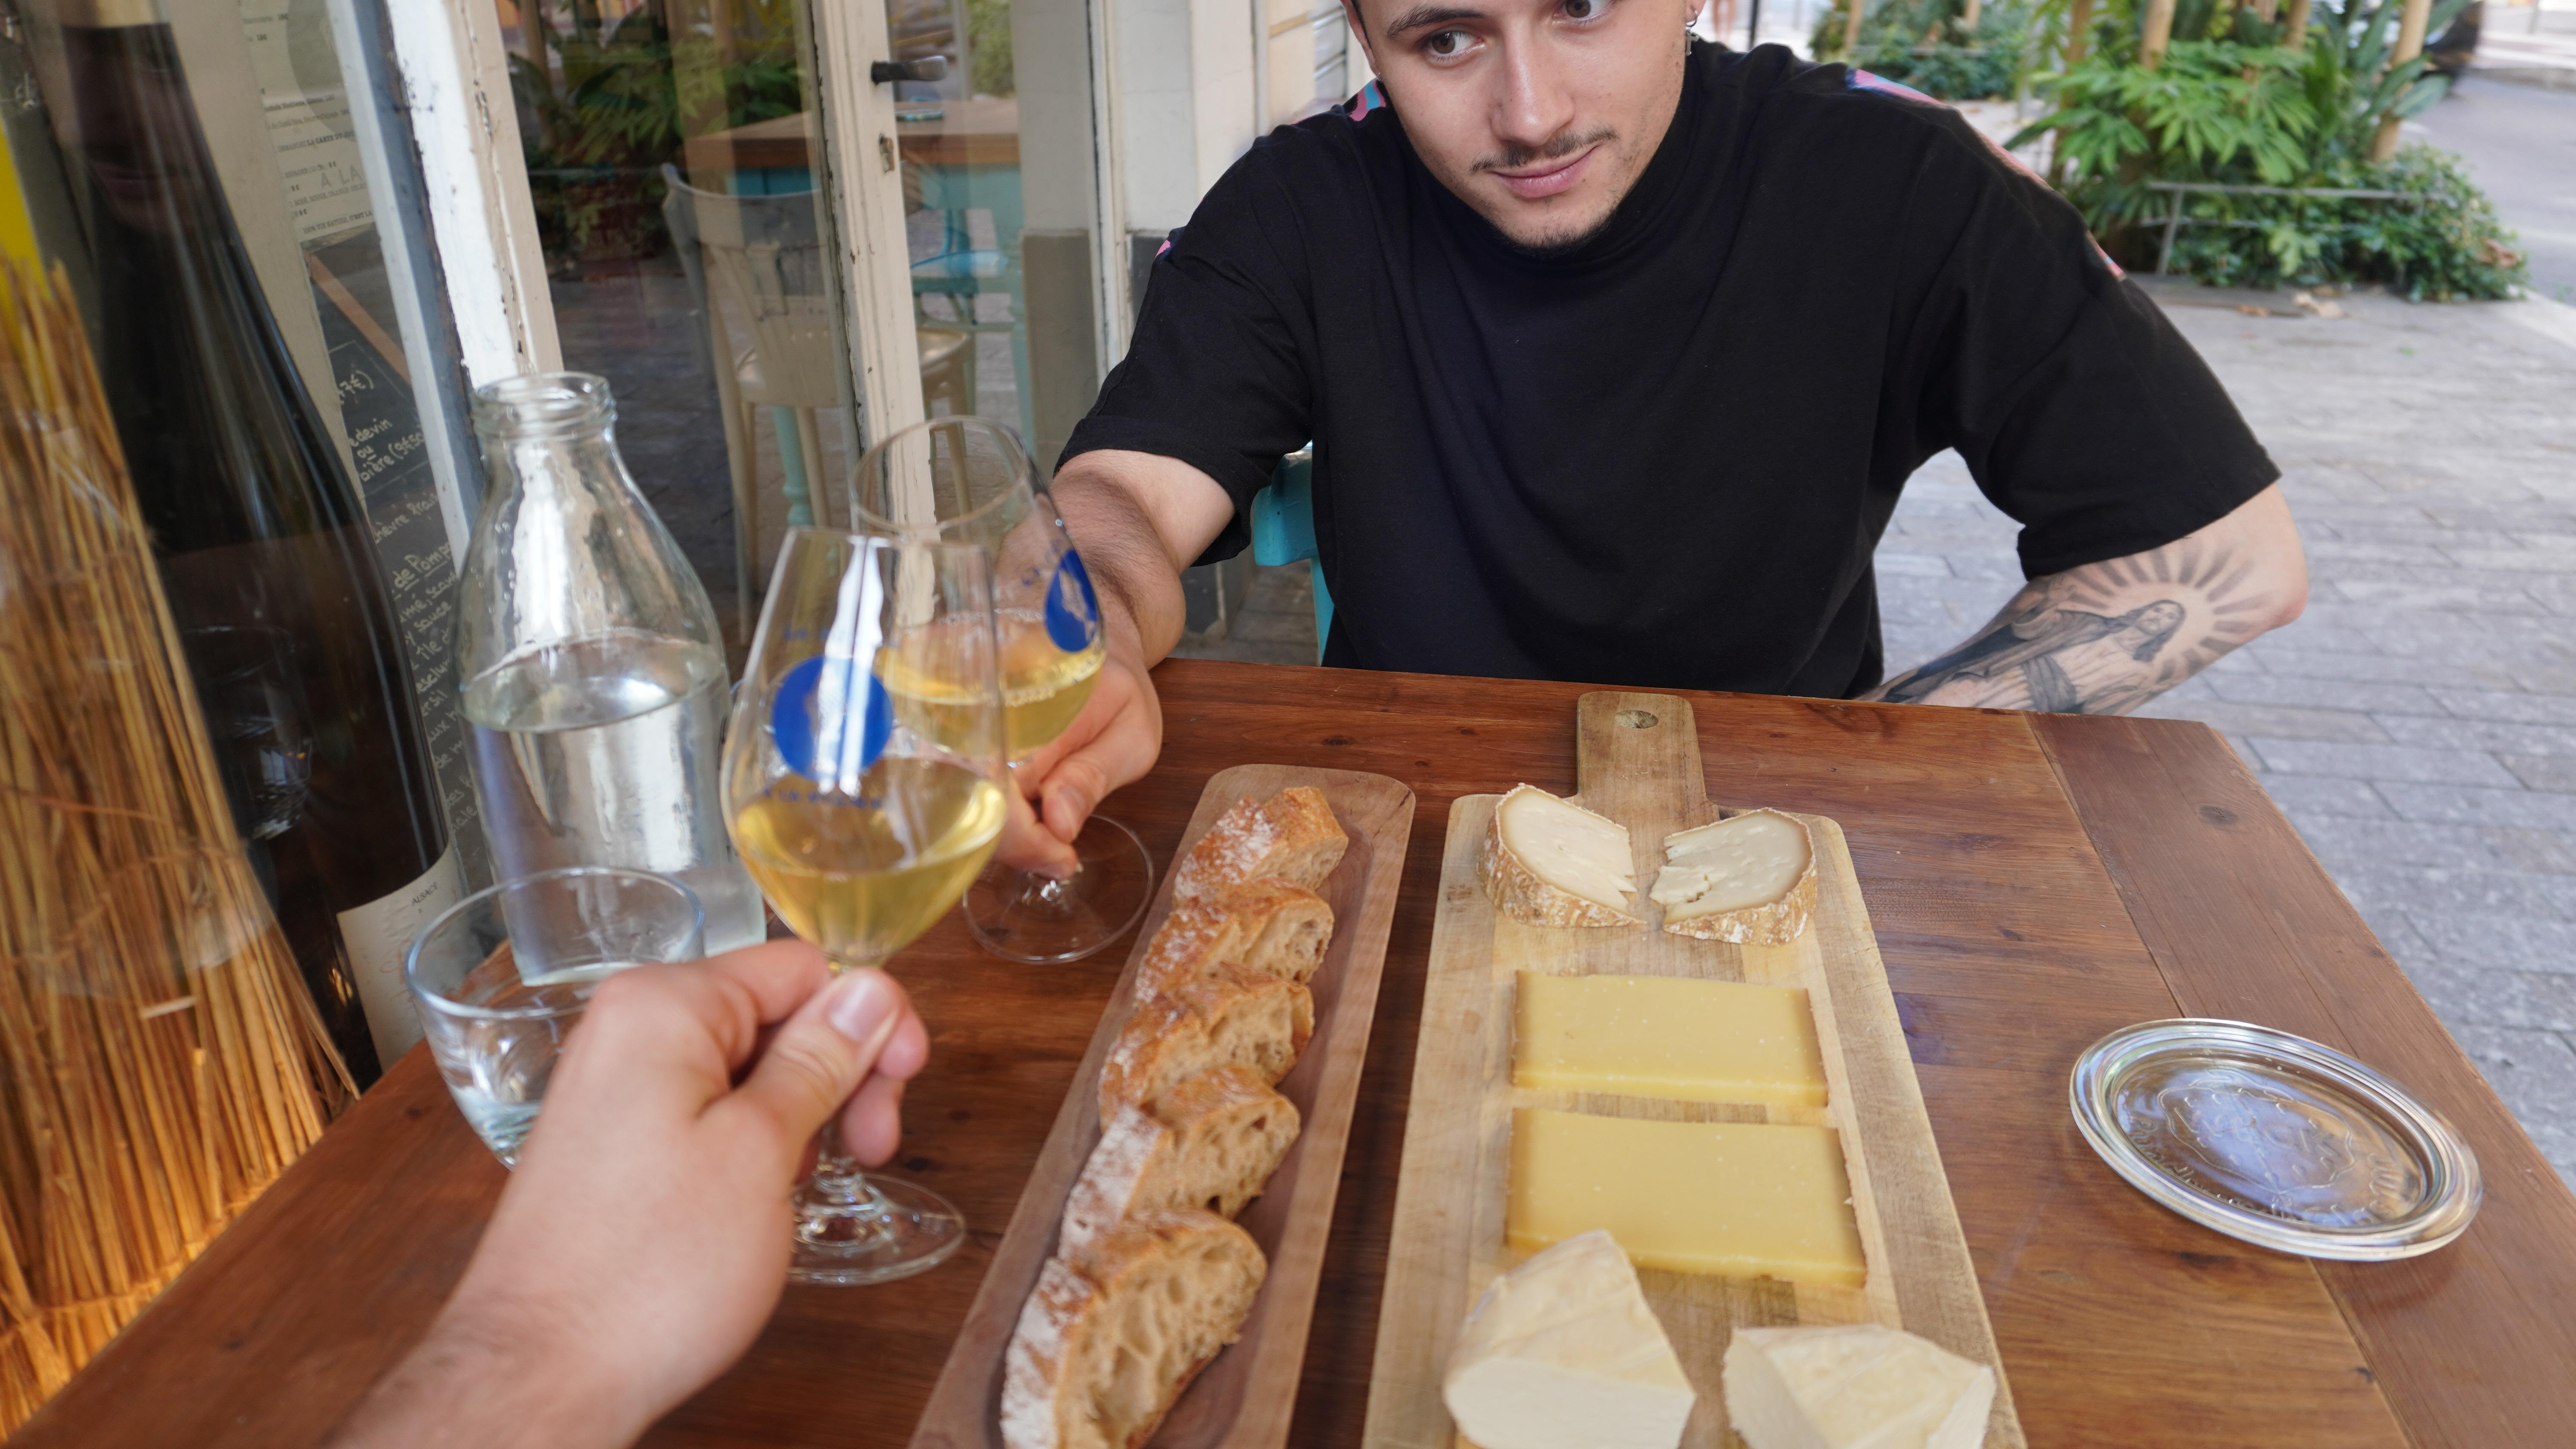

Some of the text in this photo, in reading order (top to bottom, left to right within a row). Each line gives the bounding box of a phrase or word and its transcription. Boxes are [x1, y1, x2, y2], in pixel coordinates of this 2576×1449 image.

[392, 569, 416, 589] de
[411, 881, 438, 906] ALSACE
[2174, 1106, 2339, 1157] WECK
